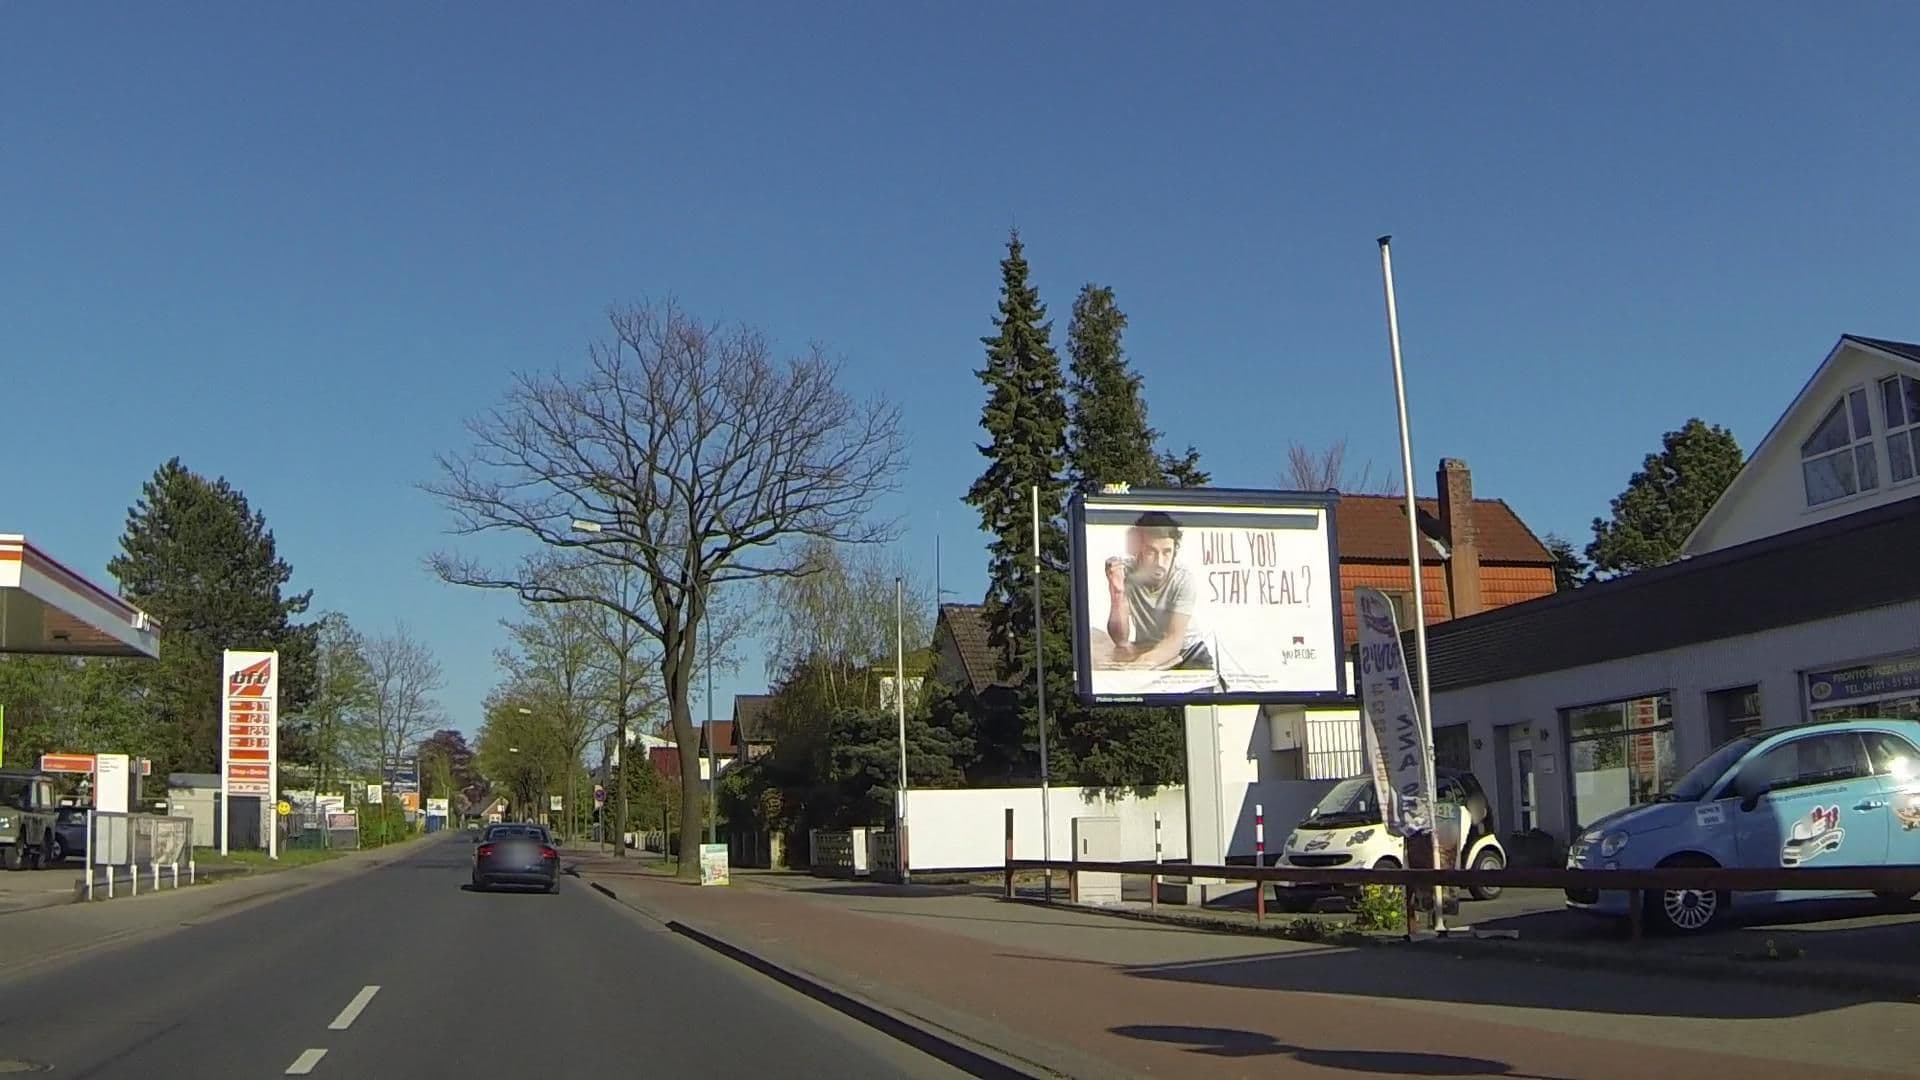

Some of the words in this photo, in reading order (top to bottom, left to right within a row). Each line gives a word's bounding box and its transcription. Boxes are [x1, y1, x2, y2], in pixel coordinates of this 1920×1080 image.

[1103, 481, 1131, 495] awk
[1201, 531, 1241, 566] WILL
[1246, 532, 1277, 567] YOU
[1209, 570, 1249, 605] STAY
[1258, 565, 1312, 608] REAL?
[232, 671, 268, 687] bft
